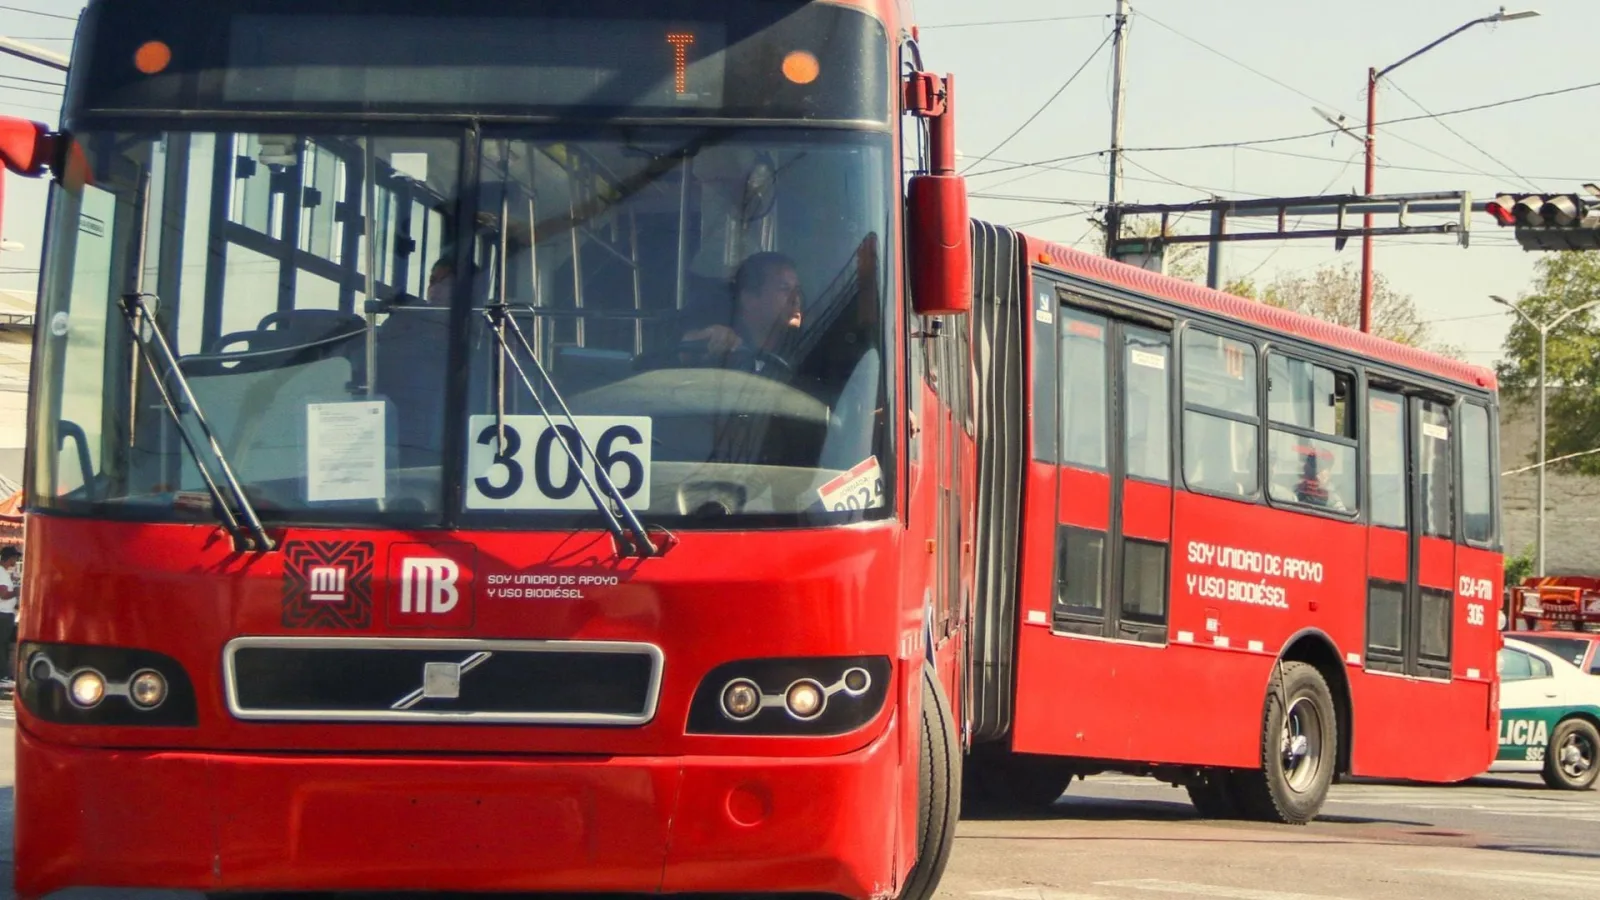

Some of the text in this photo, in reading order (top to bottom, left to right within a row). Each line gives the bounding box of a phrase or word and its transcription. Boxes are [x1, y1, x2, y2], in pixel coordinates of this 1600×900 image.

[474, 424, 645, 500] 306
[1187, 541, 1324, 583] SOY UNIDAD DE APOYO
[400, 557, 459, 614] MB
[487, 574, 618, 586] SOY UNIDAD DE APOYO
[487, 586, 585, 599] Y USO BIODIÉSEL
[1186, 573, 1290, 609] Y USO BIODIÉSEL
[1467, 603, 1484, 626] 306
[1525, 747, 1546, 761] SSC
